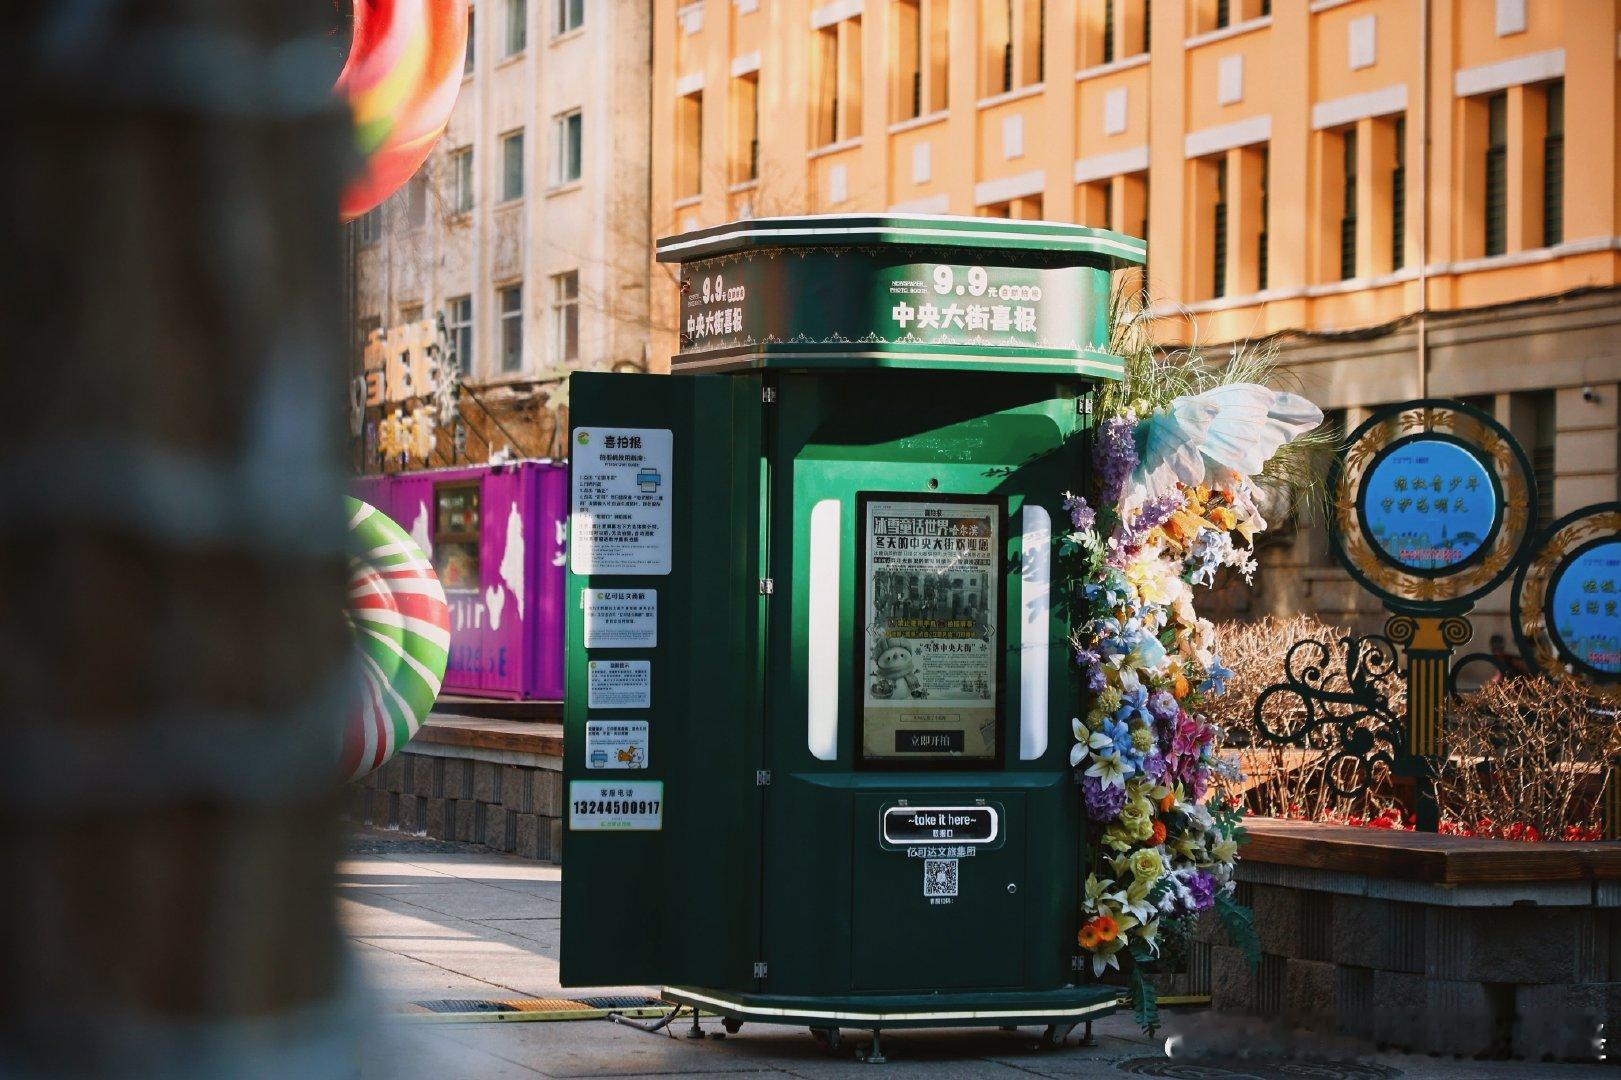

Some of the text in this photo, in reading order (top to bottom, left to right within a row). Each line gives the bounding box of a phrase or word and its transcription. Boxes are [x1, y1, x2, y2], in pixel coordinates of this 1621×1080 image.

[687, 307, 743, 339] 中央大街喜报
[892, 301, 1037, 332] 中央大街喜报
[603, 435, 642, 449] 喜拍报
[874, 518, 949, 536] 冰雪童话世界
[875, 537, 989, 551] 冬天的中央大街欢迎您
[911, 735, 951, 747] 立即开拍
[600, 788, 634, 797] 客服电话
[573, 801, 660, 814] 13244500917
[938, 813, 946, 826] it
[907, 846, 976, 858] 亿可达文旅集团
